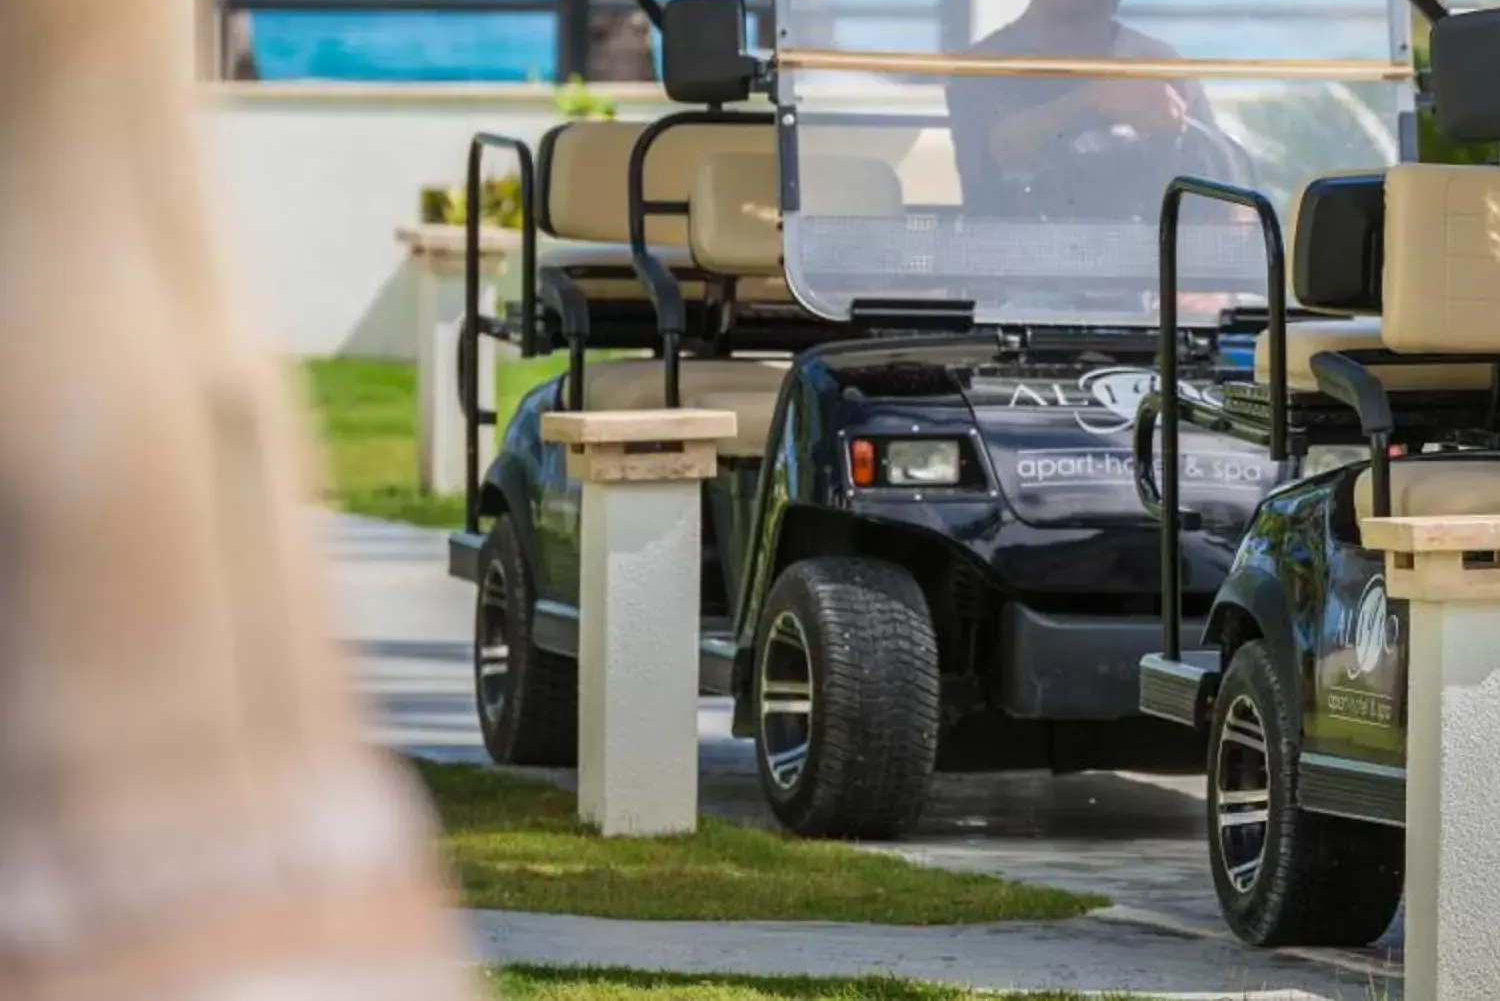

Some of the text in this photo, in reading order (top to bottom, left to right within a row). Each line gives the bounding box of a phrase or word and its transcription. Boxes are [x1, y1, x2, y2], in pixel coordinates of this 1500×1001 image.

[1016, 452, 1262, 483] apart-hoe & spa
